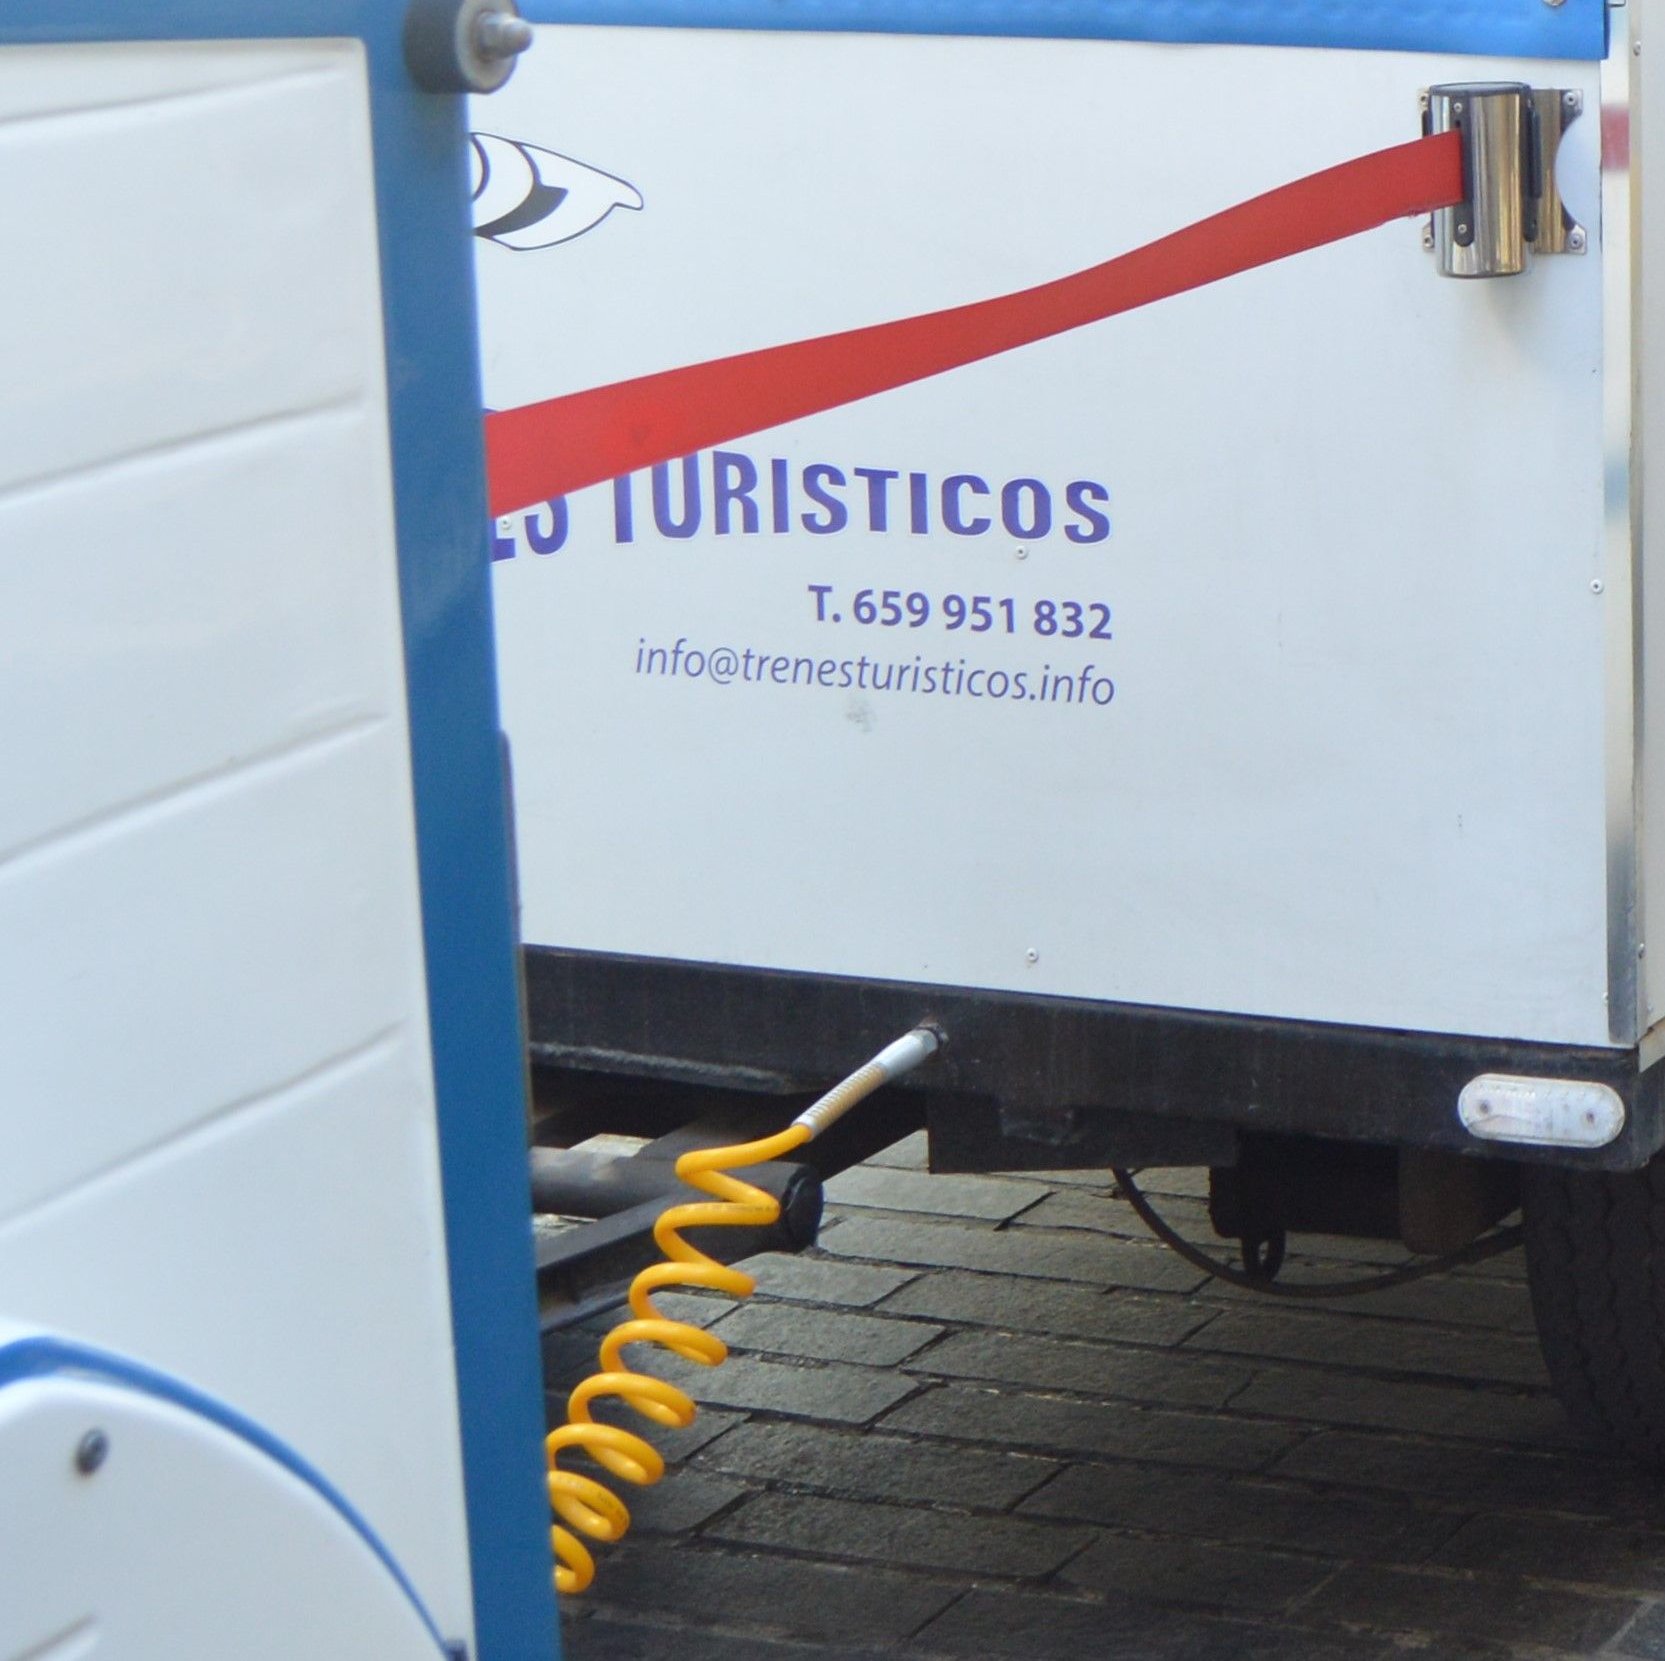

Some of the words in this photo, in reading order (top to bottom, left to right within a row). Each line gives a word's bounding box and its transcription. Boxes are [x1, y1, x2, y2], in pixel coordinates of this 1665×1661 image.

[808, 583, 842, 623] T.
[852, 589, 931, 629] 659
[942, 594, 1017, 634] 951
[1033, 599, 1114, 641] 832
[634, 637, 1116, 707] info@trenesturisticos.info
